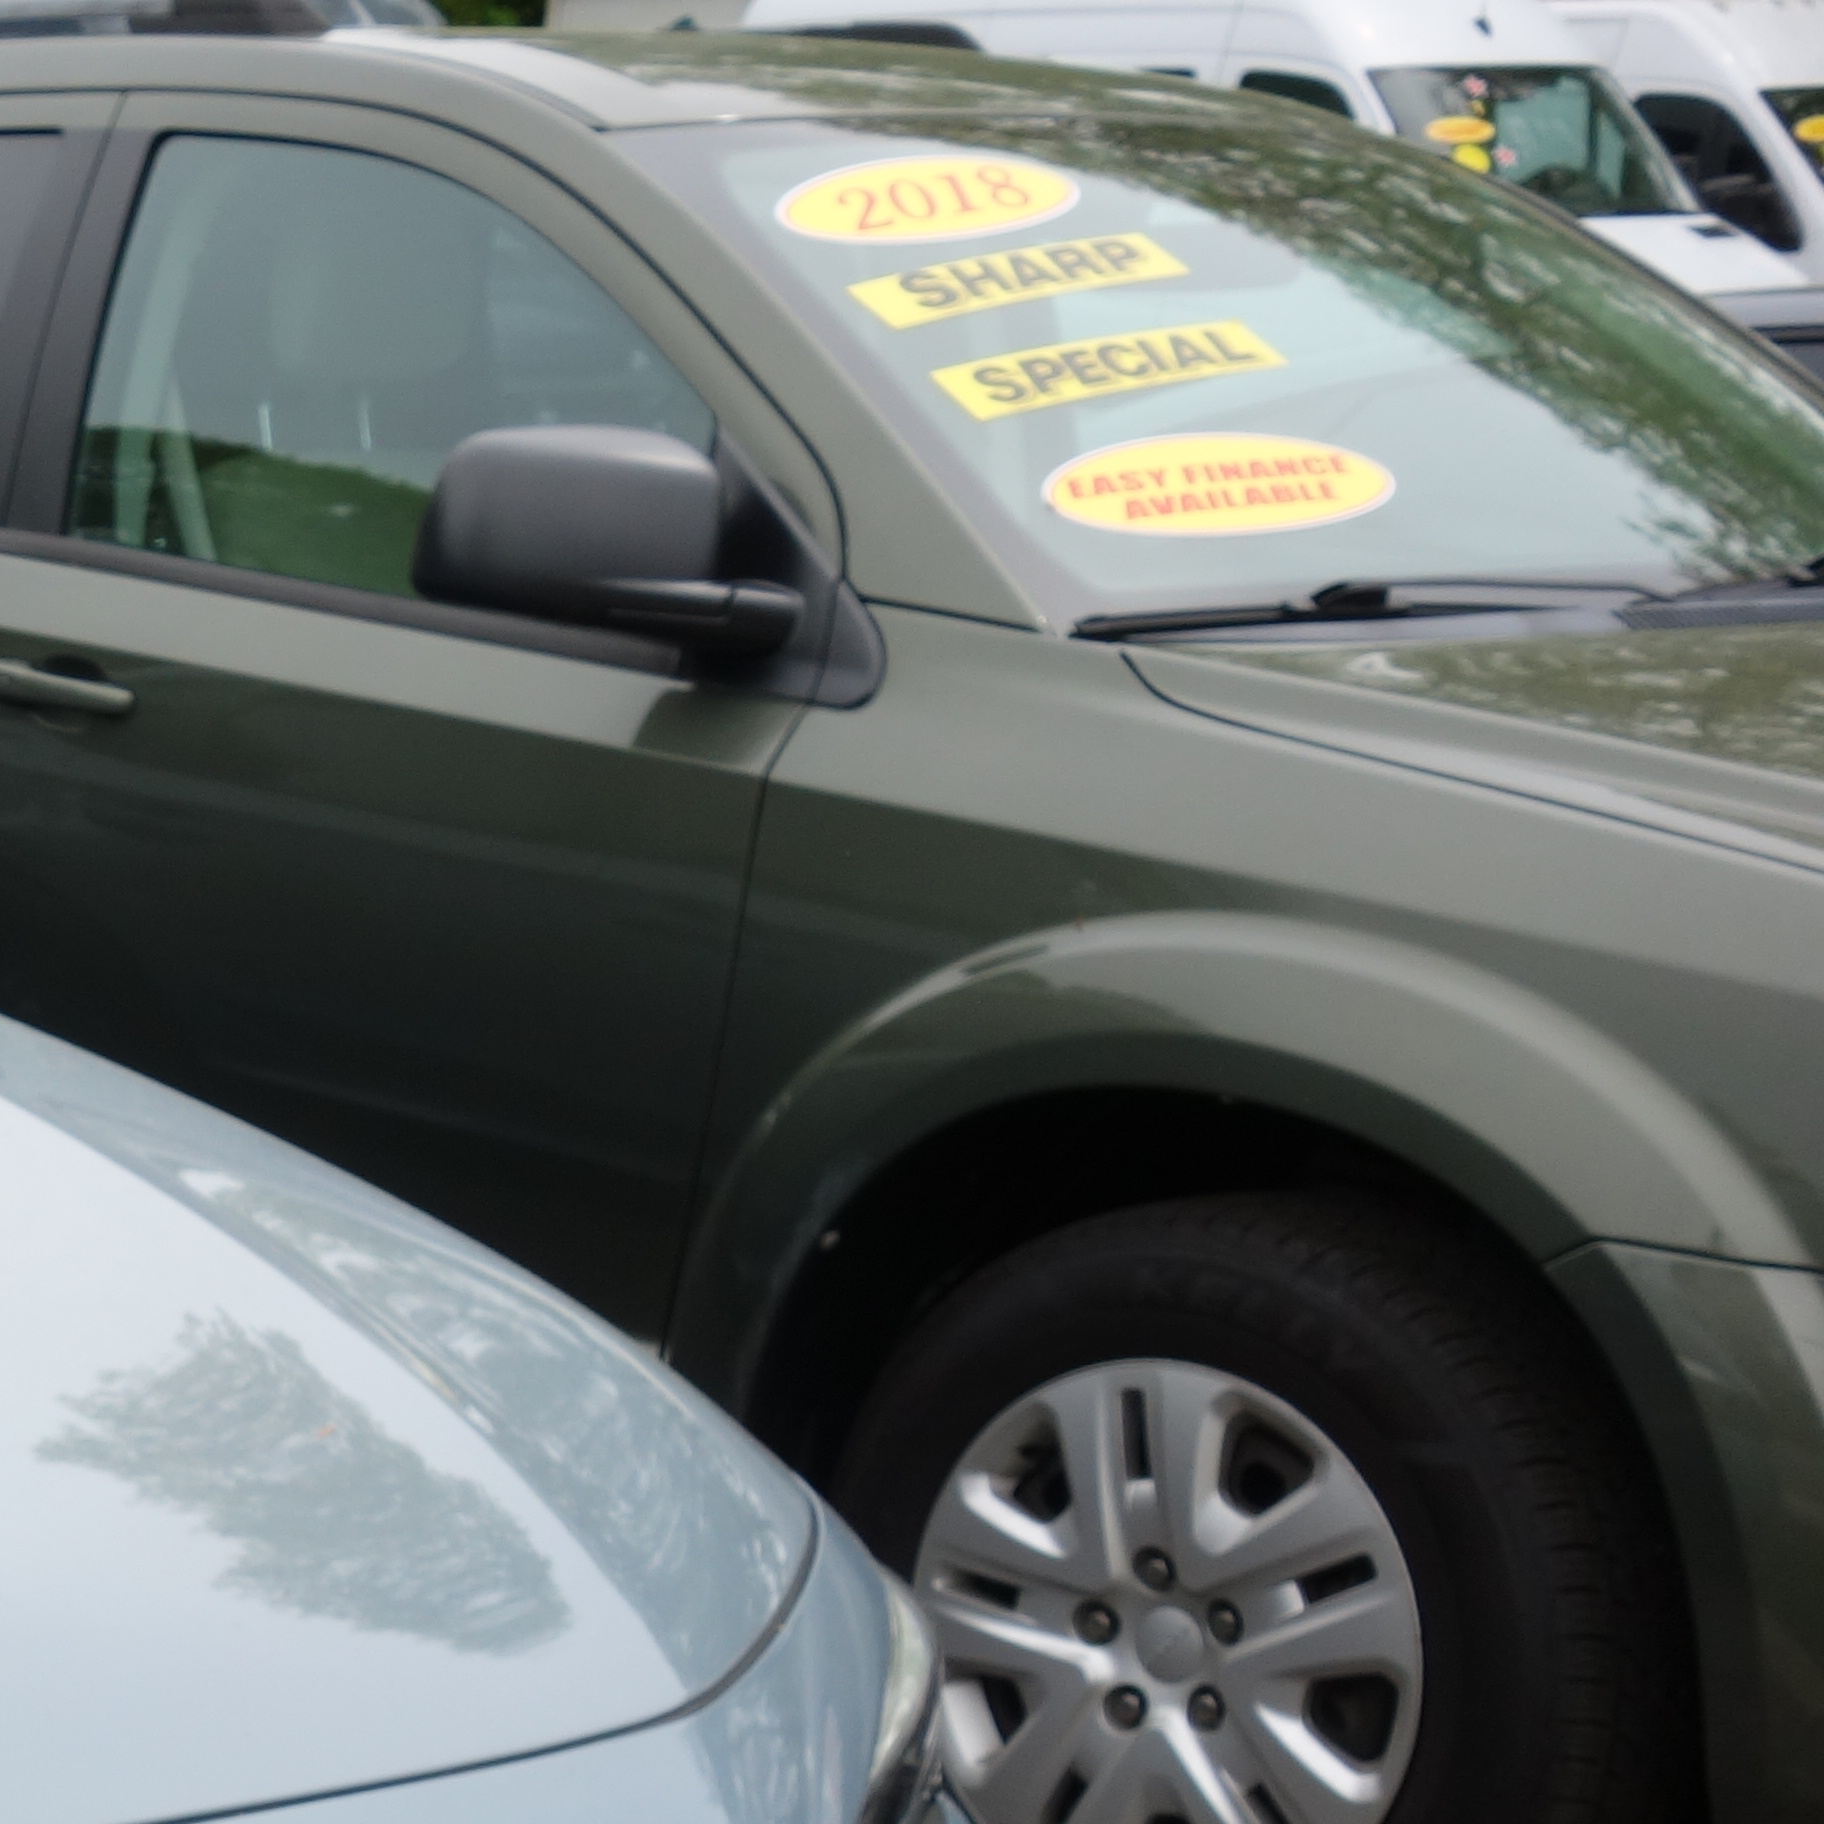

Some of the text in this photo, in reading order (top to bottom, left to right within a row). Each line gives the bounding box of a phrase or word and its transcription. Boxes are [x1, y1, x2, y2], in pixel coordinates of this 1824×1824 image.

[837, 165, 1030, 231] 2018
[899, 238, 1143, 308] SHARP
[972, 330, 1259, 402] SPECIAL
[1067, 453, 1349, 498] EASY FINANCE
[1125, 480, 1337, 520] AVAILABLE
